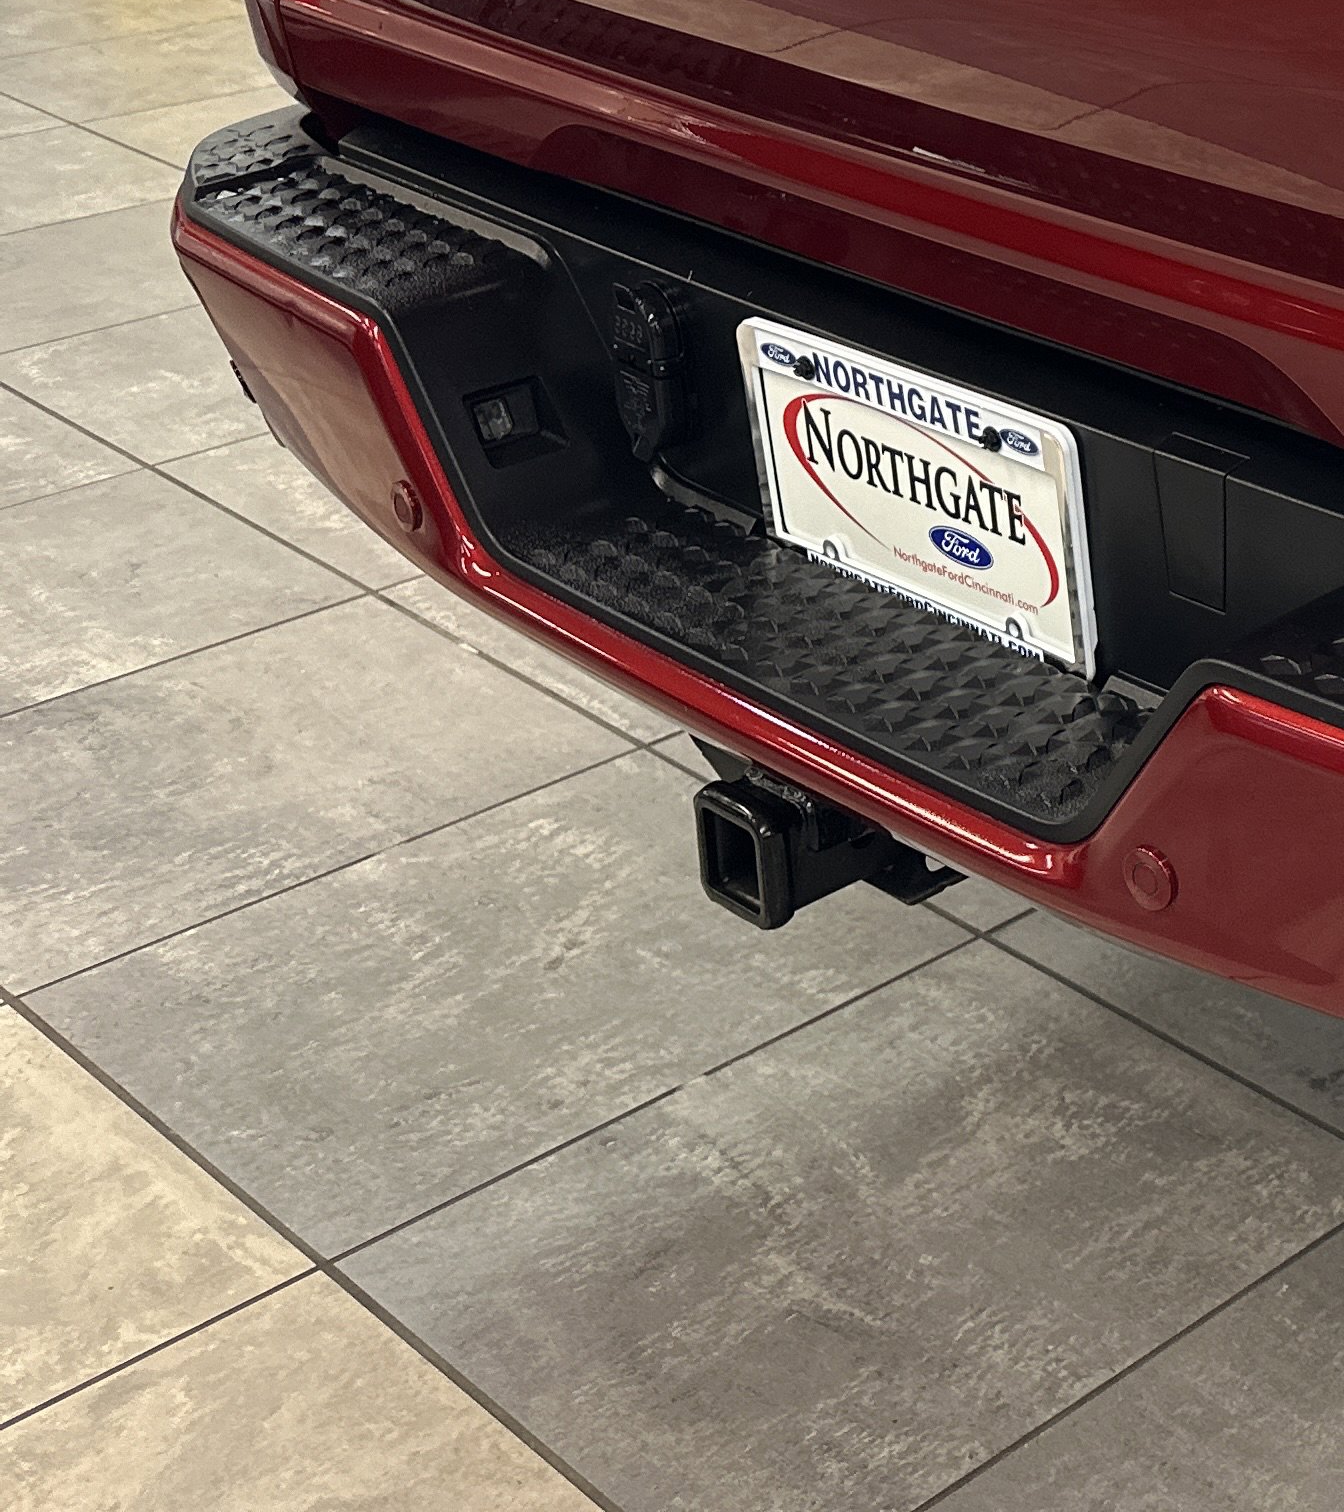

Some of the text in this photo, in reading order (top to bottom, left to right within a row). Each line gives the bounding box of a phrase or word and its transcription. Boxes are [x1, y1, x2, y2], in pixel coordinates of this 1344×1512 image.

[766, 343, 791, 365] Ford
[812, 352, 983, 439] NORTHGATE
[1007, 429, 1032, 453] Ford
[803, 399, 1027, 546] NORTHGATE
[941, 530, 981, 564] Ford
[893, 545, 1039, 616] NorthgateFordCincinnati.com
